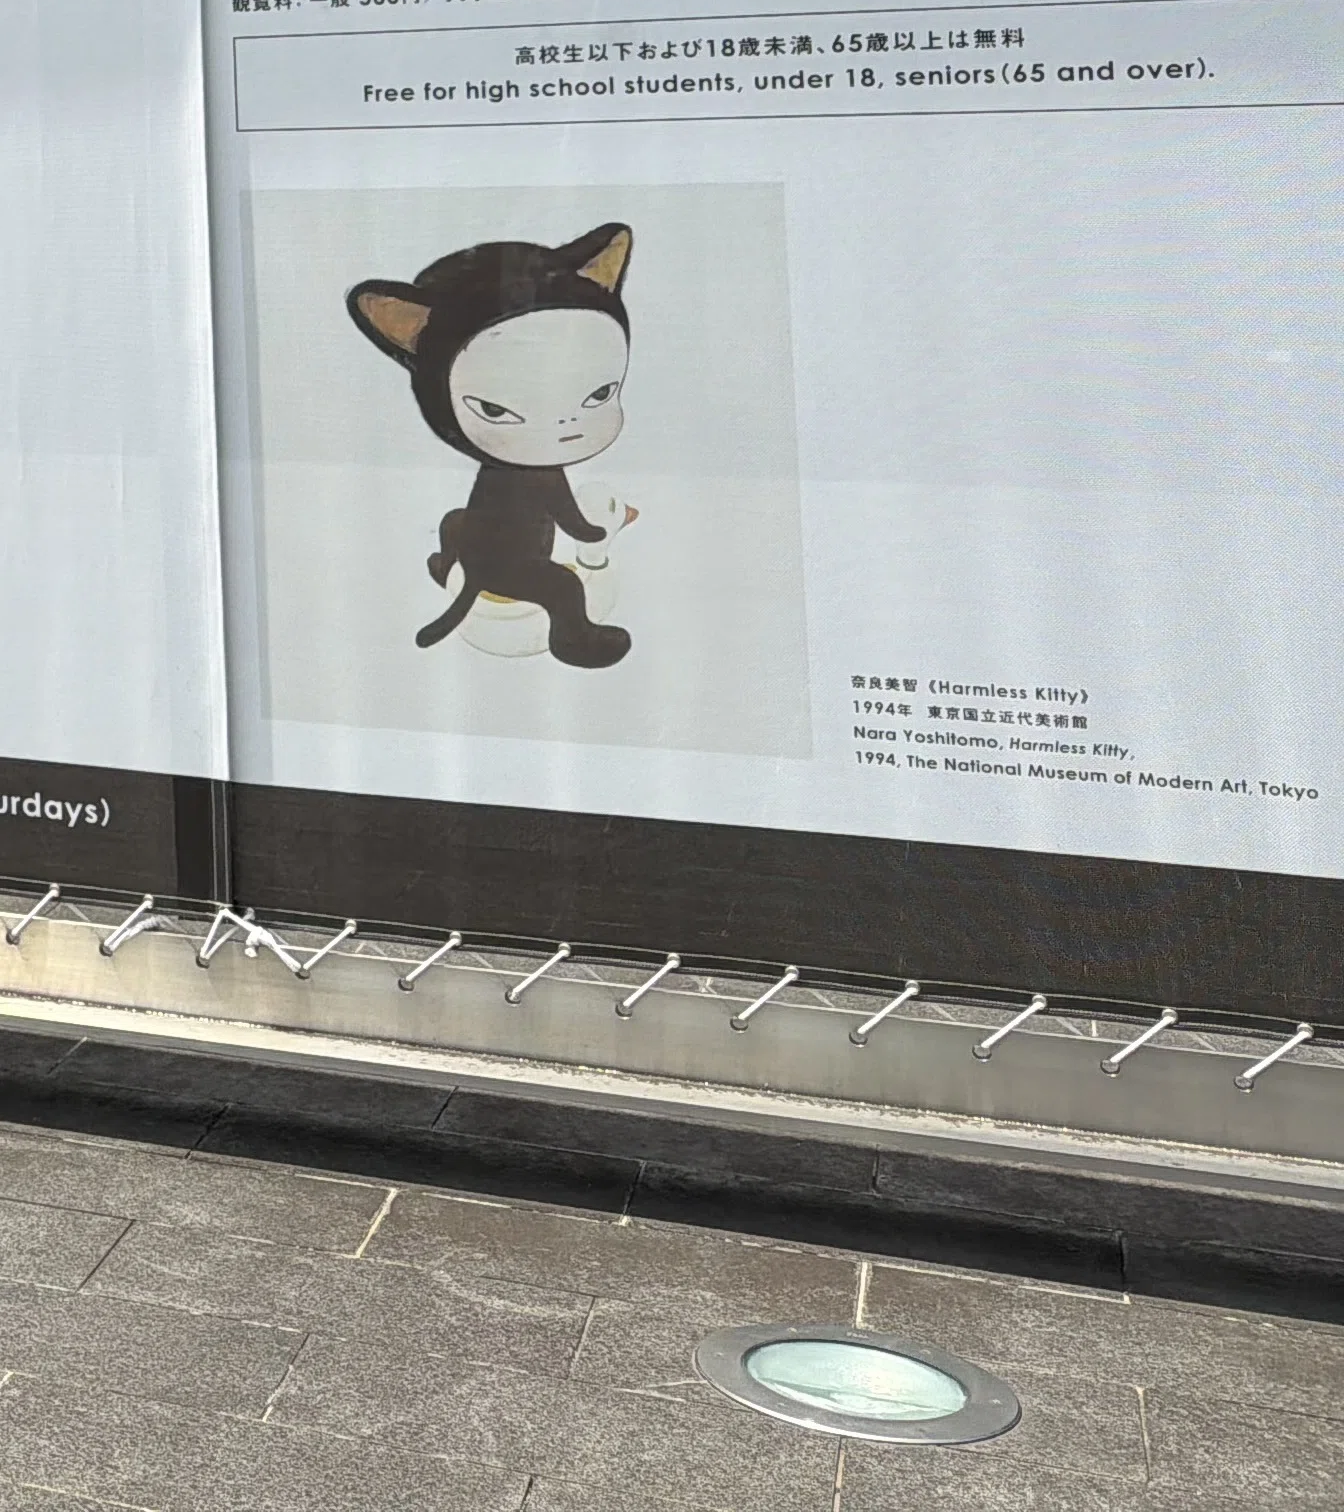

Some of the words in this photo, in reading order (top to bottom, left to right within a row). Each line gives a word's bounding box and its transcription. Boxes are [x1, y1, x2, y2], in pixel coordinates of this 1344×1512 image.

[363, 84, 415, 103] Free
[423, 82, 457, 101] for
[465, 79, 520, 103] high
[529, 76, 615, 98] school
[624, 72, 743, 95] students,
[754, 69, 834, 91] under
[845, 67, 884, 90] 18,
[1057, 60, 1115, 82] and
[1126, 56, 1215, 80] over).
[852, 699, 913, 717] 1994年
[927, 705, 1088, 730] 東京国立近代美術館
[853, 725, 897, 742] Nara
[902, 729, 1004, 751] Yoshitomo,
[1009, 736, 1087, 755] Harmless
[1092, 743, 1136, 761] Kitty,
[855, 750, 901, 769] 1994,
[906, 754, 938, 770] The
[944, 757, 1022, 777] National
[1027, 763, 1108, 784] Museum
[1113, 770, 1133, 786] of
[1138, 772, 1214, 792] Modern
[1220, 778, 1253, 796] Art,
[1258, 780, 1319, 802] Tokyo
